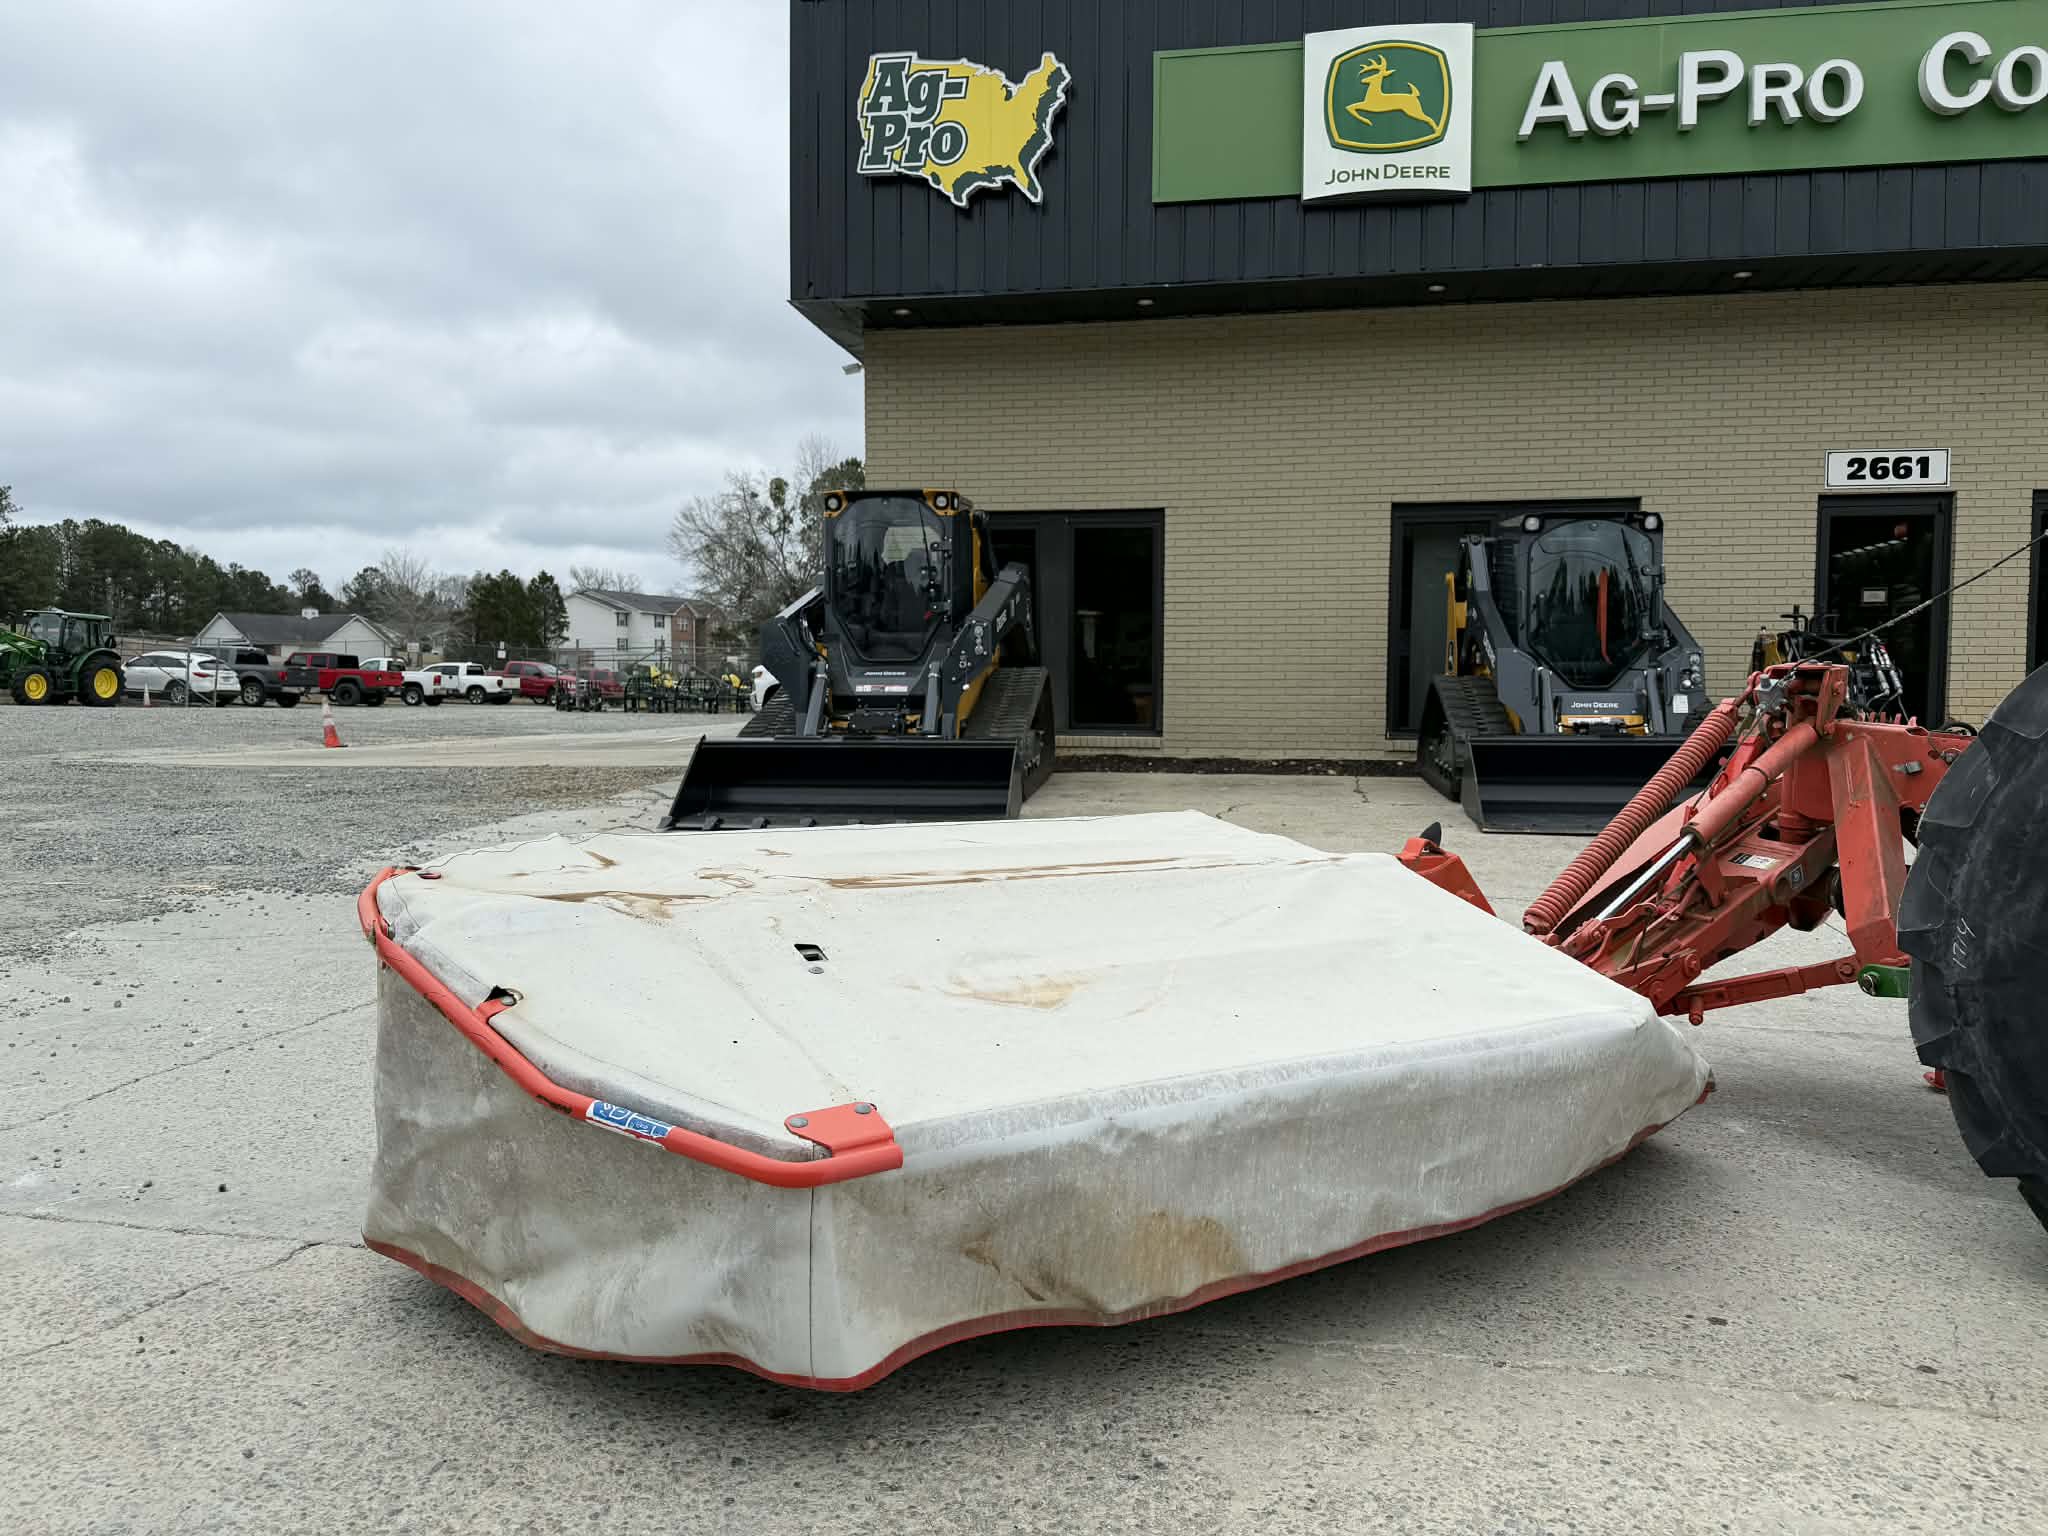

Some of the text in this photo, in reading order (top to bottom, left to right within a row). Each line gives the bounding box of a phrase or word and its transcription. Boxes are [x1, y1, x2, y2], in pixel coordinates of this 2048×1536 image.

[863, 58, 968, 124] Ag-
[861, 113, 968, 170] Pro
[1325, 163, 1451, 185] JOHN DEERE
[1846, 456, 1930, 481] 2661
